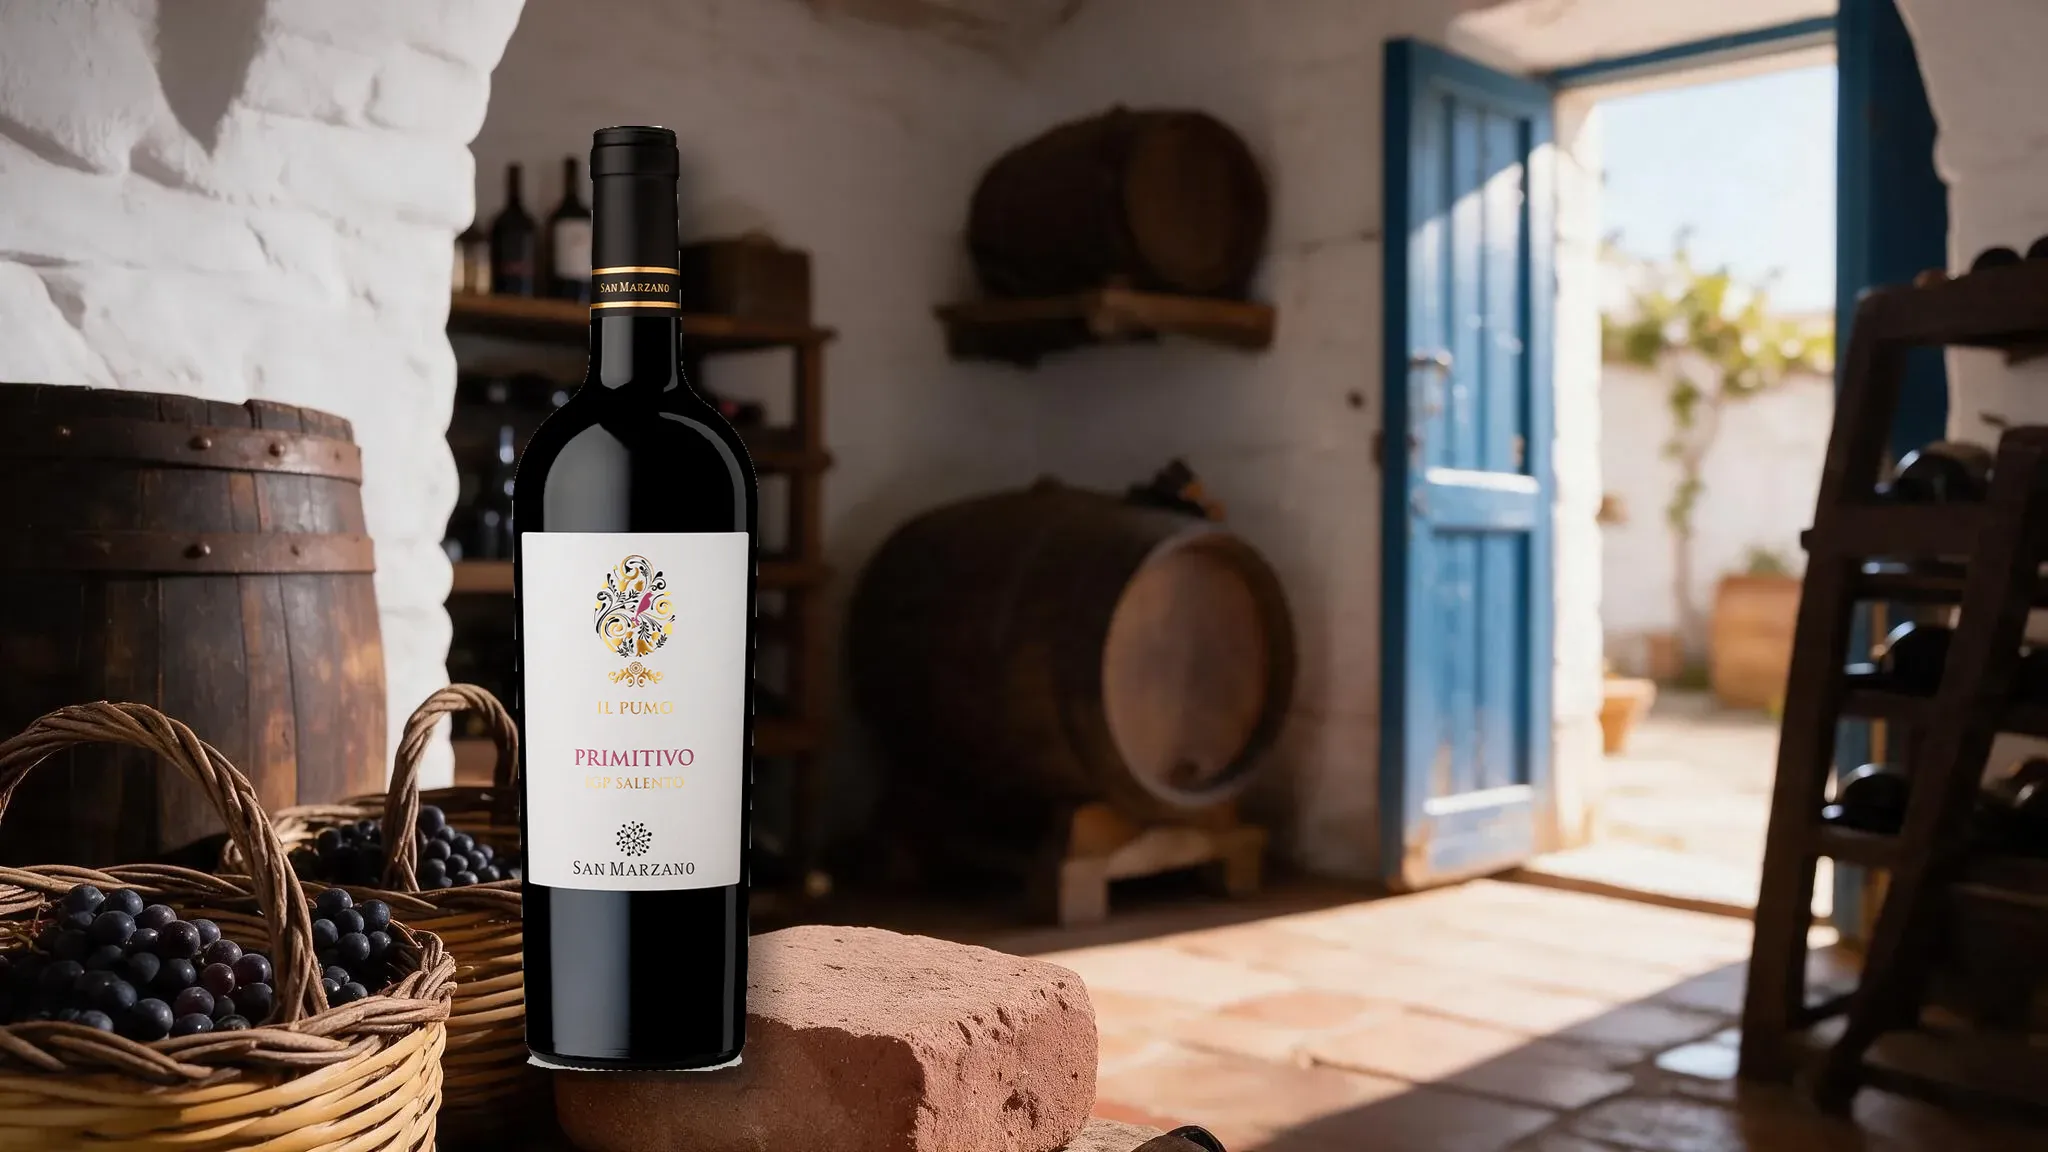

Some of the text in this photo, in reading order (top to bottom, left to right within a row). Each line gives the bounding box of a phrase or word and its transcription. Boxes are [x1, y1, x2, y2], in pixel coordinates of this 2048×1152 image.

[600, 281, 670, 293] SAN MARZANO
[597, 701, 674, 715] IL PUMO
[575, 748, 695, 767] PRIMITIVO
[616, 776, 685, 790] SALENTO
[573, 860, 695, 877] SAN MARZANO
